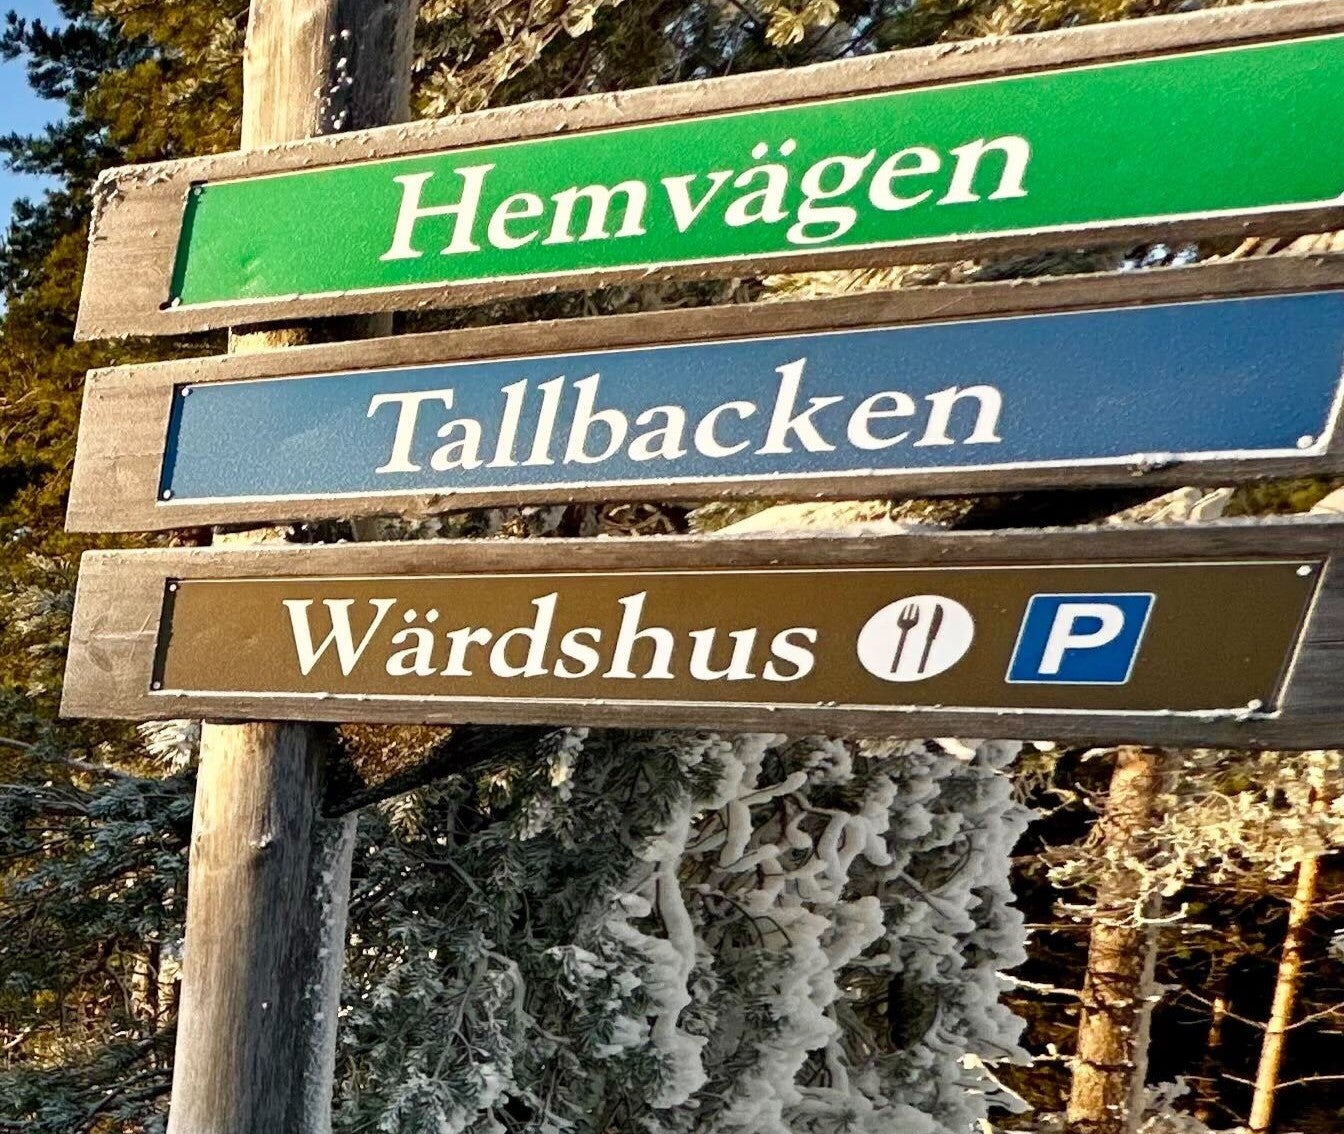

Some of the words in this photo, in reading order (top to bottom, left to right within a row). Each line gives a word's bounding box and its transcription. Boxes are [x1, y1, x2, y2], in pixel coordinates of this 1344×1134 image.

[379, 135, 1030, 261] Hemvägen
[366, 357, 1002, 475] Tallbacken
[282, 591, 818, 682] Wärdshus
[1038, 603, 1124, 674] P
